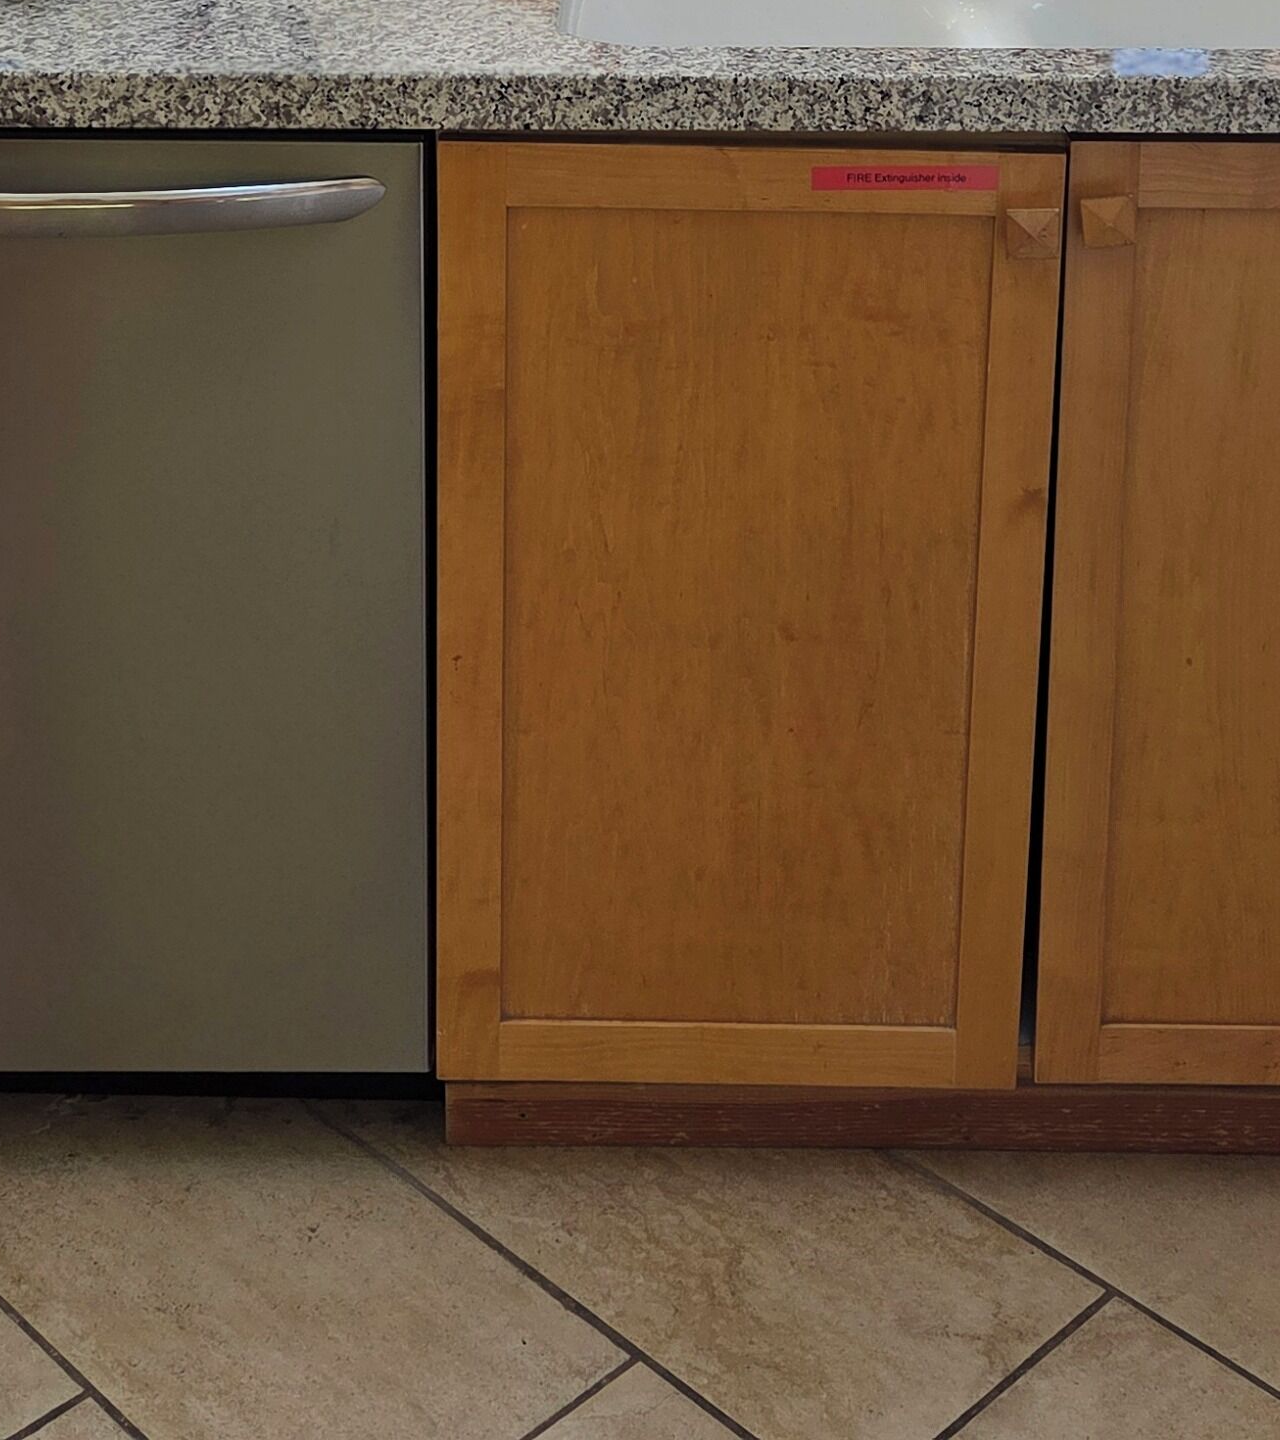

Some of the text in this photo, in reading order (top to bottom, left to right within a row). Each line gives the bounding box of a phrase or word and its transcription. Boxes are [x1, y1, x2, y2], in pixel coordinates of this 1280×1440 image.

[846, 172, 967, 185] FIRE Extinguisher inside
